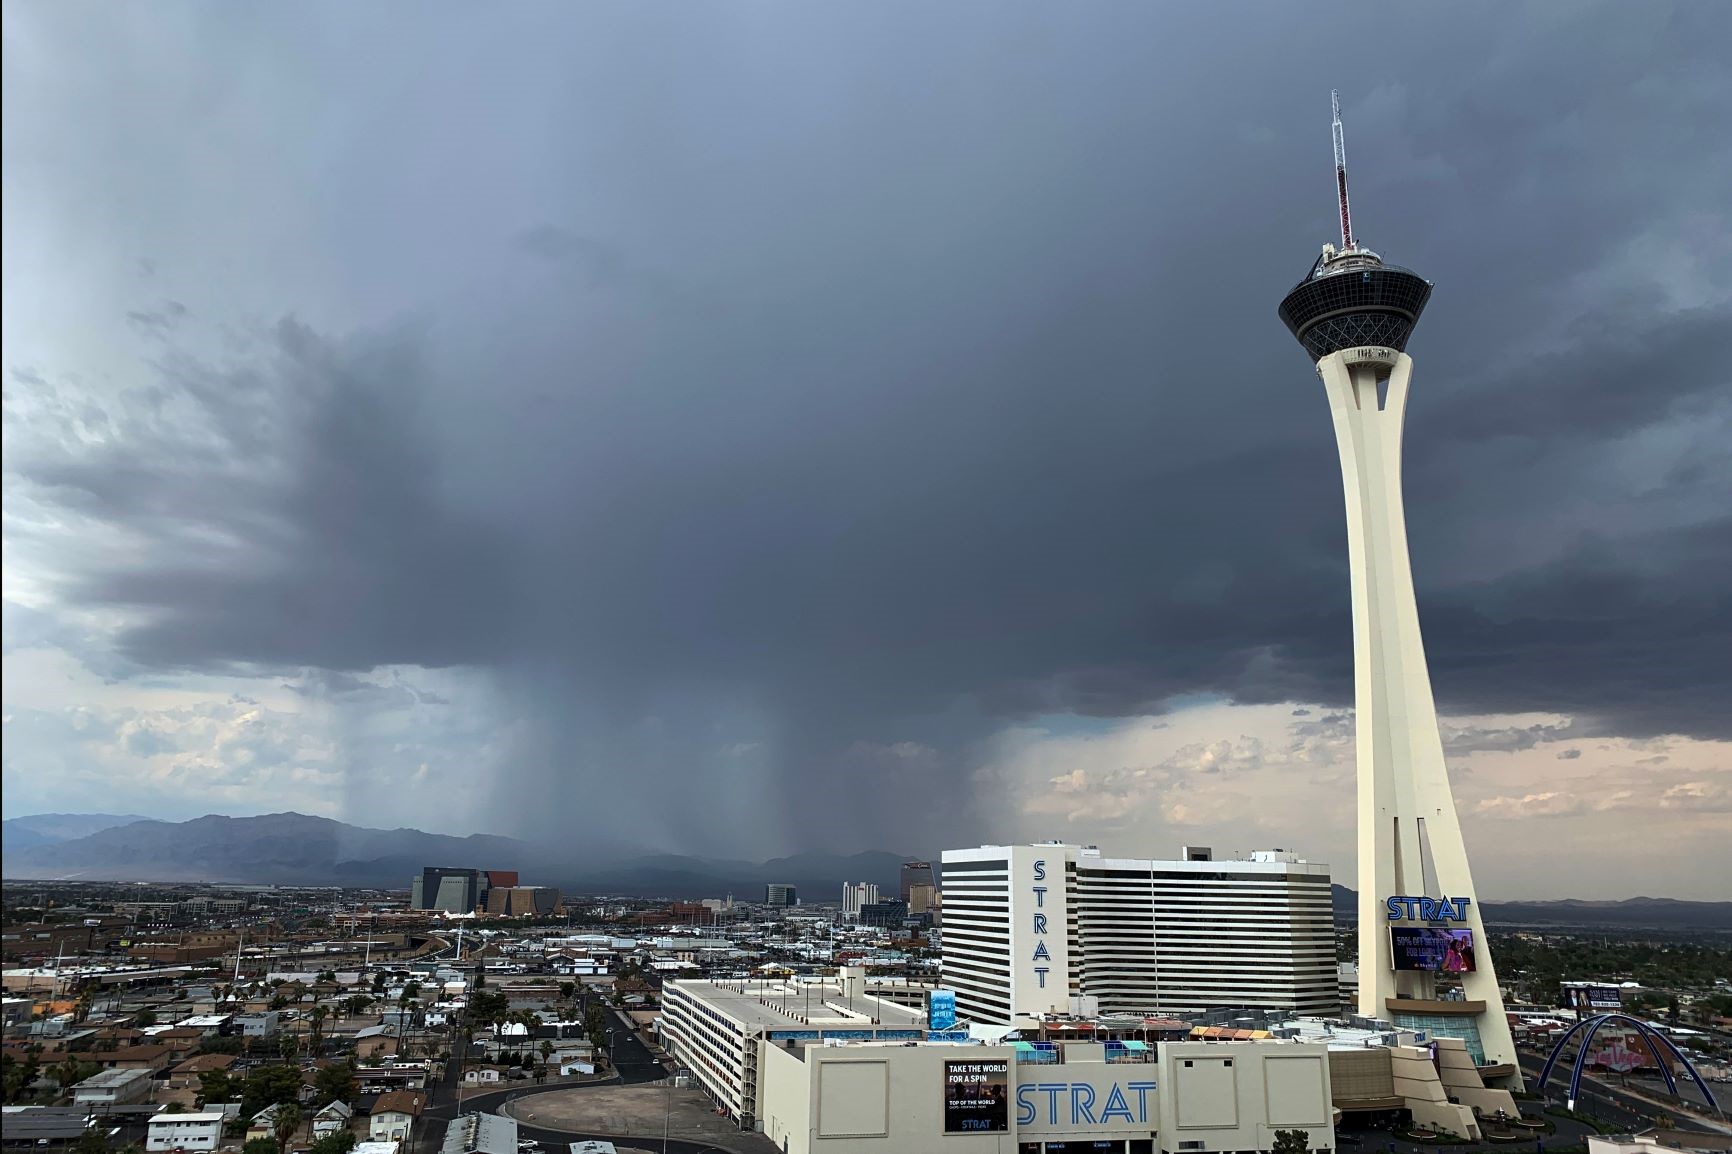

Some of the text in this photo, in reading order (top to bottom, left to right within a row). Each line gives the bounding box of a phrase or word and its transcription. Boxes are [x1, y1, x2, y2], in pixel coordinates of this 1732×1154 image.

[1387, 895, 1470, 921] STRAT
[1033, 860, 1051, 988] STRAT
[949, 1075, 987, 1083] FOR A SPIN
[1017, 1082, 1157, 1126] STRAT
[962, 1119, 992, 1129] STRAT
